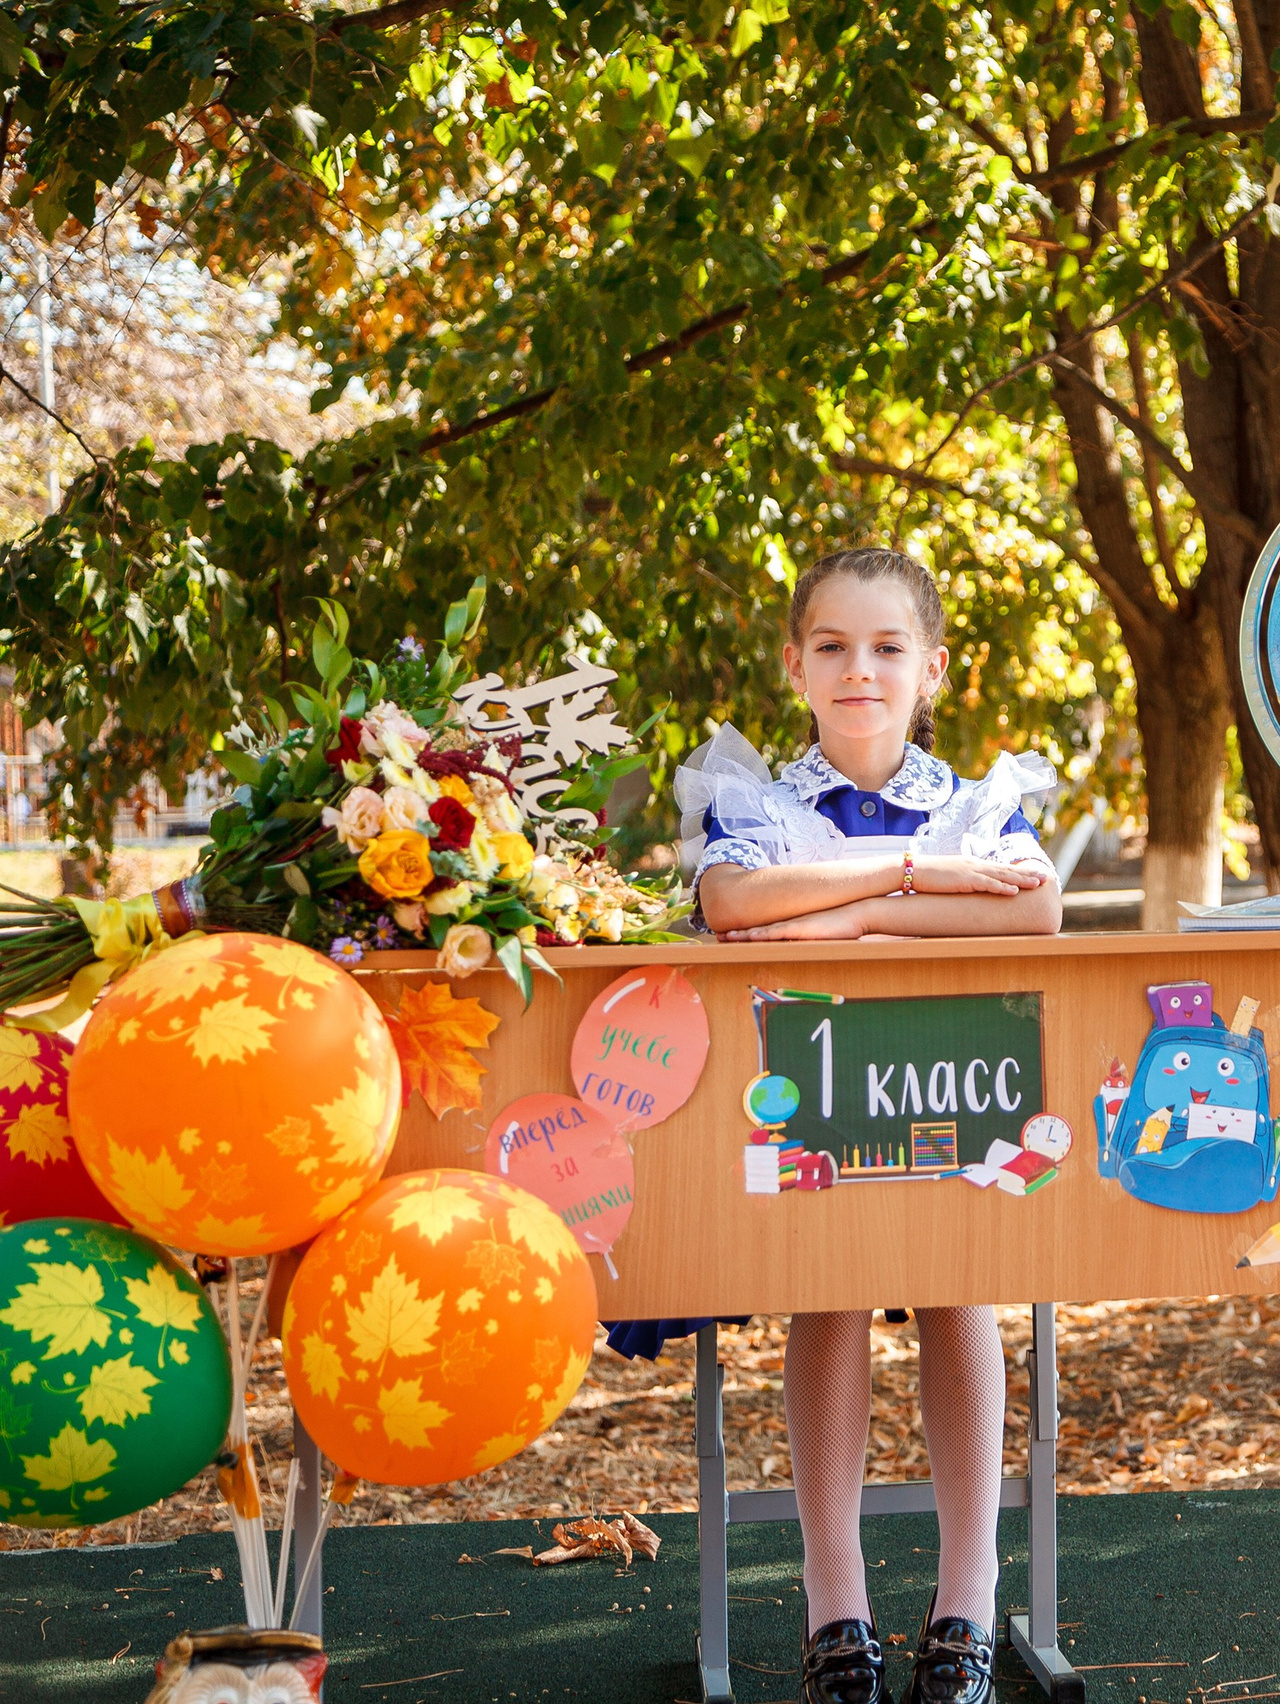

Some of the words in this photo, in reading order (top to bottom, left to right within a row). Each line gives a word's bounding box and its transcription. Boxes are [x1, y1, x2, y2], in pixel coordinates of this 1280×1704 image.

[810, 1018, 834, 1118] 1
[867, 1057, 1023, 1117] класс
[551, 1156, 580, 1183] за
[560, 1183, 633, 1228] ниями
